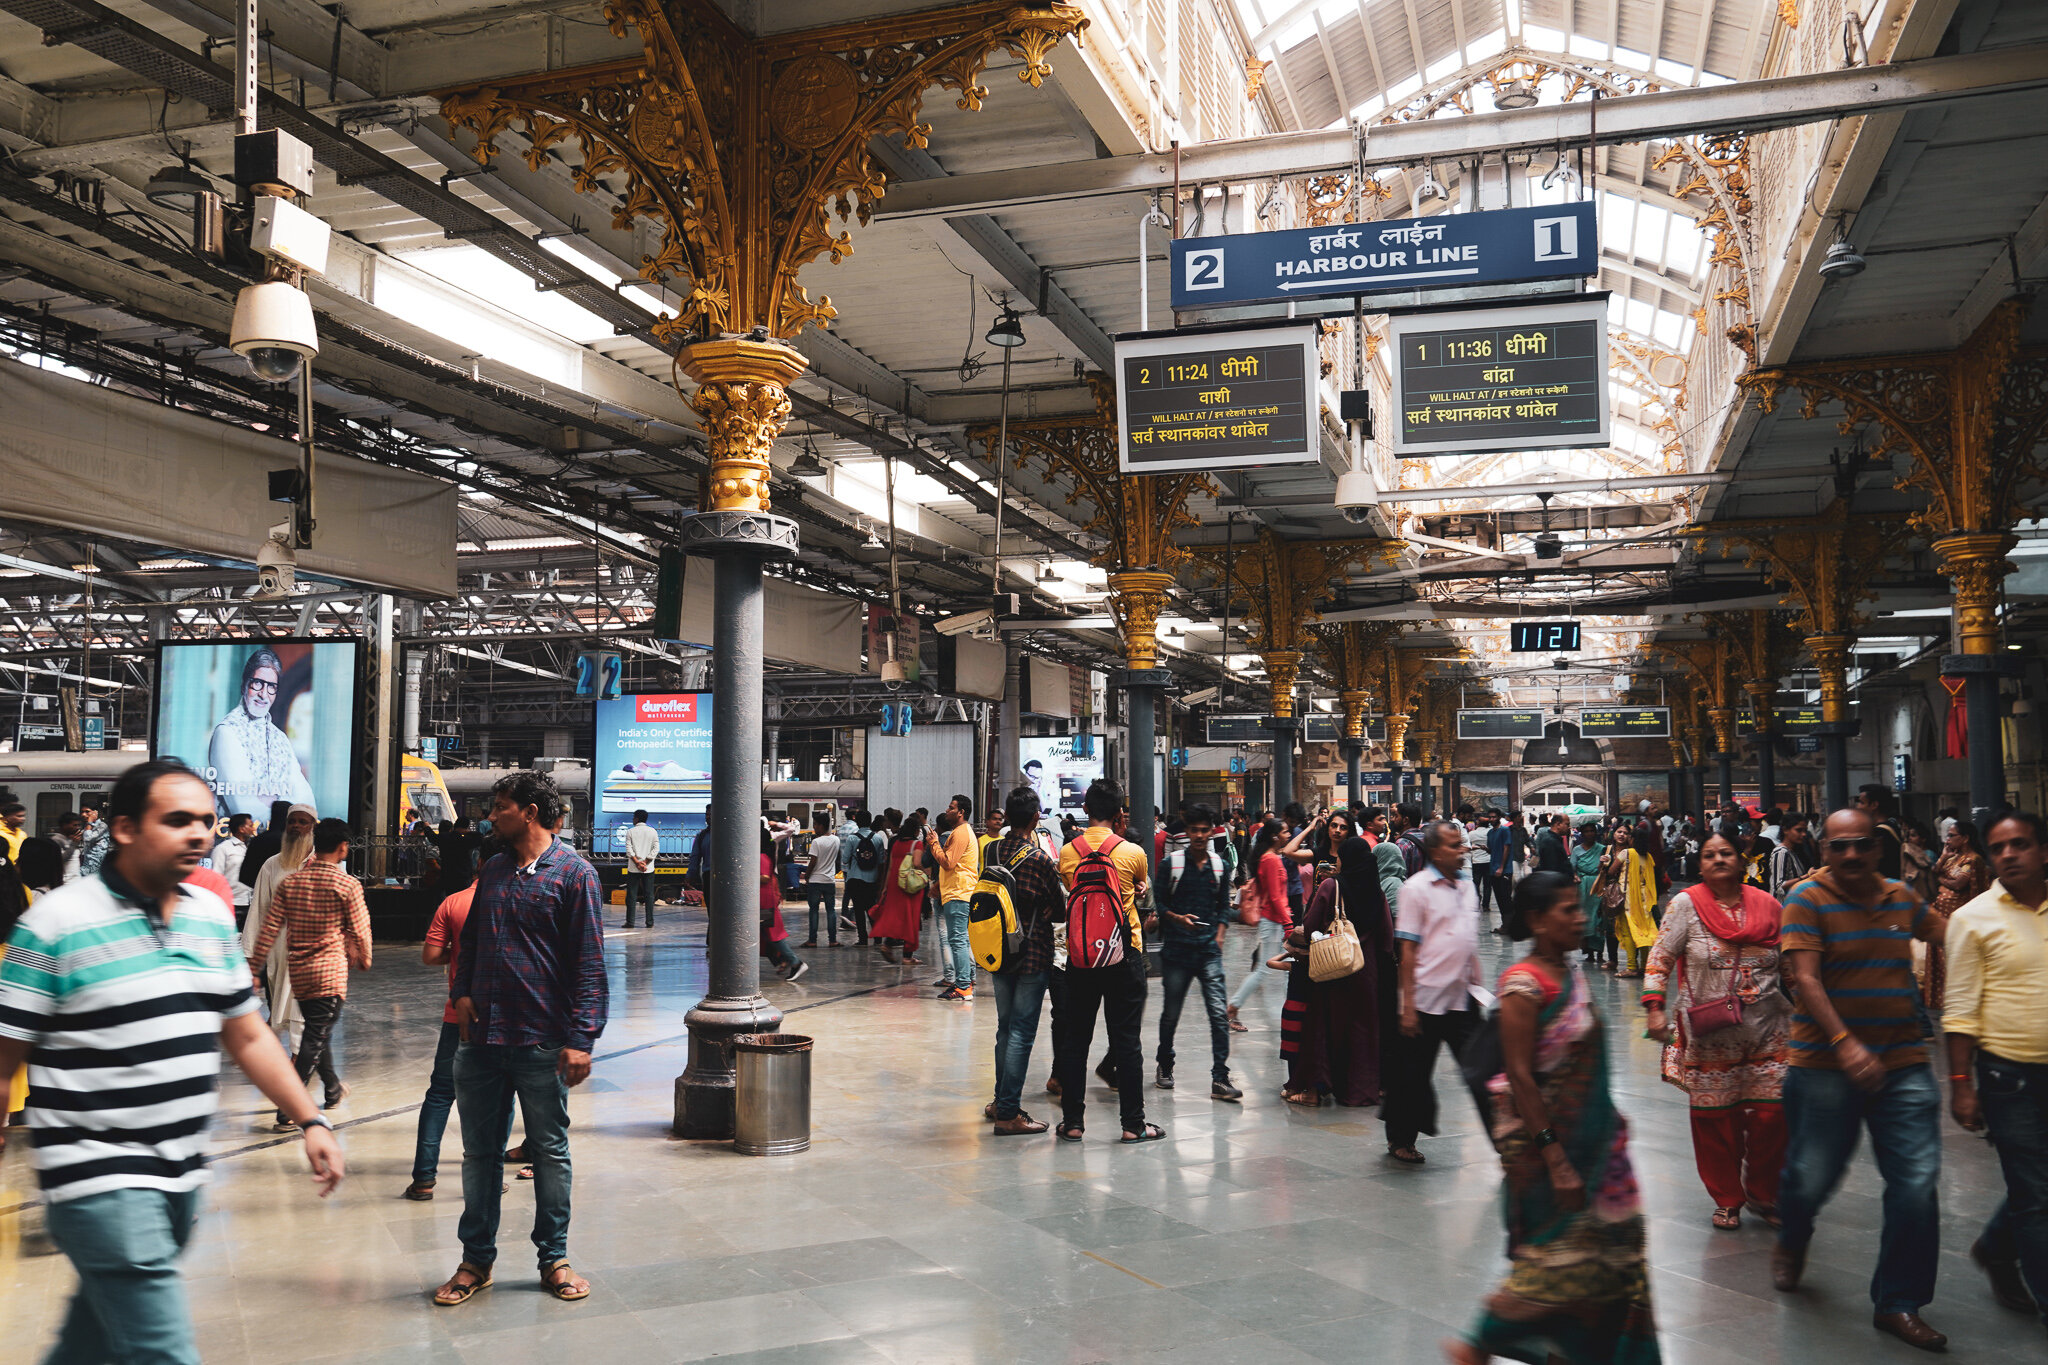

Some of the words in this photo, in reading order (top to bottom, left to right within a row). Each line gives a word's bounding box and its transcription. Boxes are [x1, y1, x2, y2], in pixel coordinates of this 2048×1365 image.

[1309, 228, 1362, 254] हार्बर
[1378, 221, 1446, 246] लाईन
[1540, 221, 1572, 257] 1
[1191, 254, 1219, 286] 2
[1275, 251, 1407, 276] HARBOUR
[1416, 244, 1478, 265] LINE
[1418, 344, 1426, 361] 1
[1447, 340, 1492, 359] 11:36
[1505, 332, 1548, 356] धीमी
[1140, 368, 1150, 384] 2
[1167, 363, 1209, 382] 11:24
[1220, 355, 1259, 378] धीमी
[1482, 366, 1515, 384] बांद्रा
[1199, 387, 1231, 405] वाशी
[1430, 393, 1452, 402] WILL
[1452, 391, 1475, 401] HALT
[1477, 390, 1490, 400] AT
[1152, 415, 1172, 423] WILL
[1173, 412, 1194, 422] HALT
[1196, 411, 1206, 420] AT
[1406, 406, 1431, 424] सर्व
[1515, 400, 1559, 418] थांबेल
[1131, 427, 1154, 444] सर्व
[1230, 420, 1270, 438] थांबेल
[1521, 626, 1578, 649] 1121
[576, 655, 593, 695] 2
[602, 656, 622, 697] 2
[641, 699, 691, 712] duroflex
[881, 704, 894, 732] 3
[901, 706, 912, 733] 3
[616, 739, 674, 750] Orthopaedic
[618, 728, 648, 738] India's
[649, 728, 671, 739] Only
[1072, 735, 1083, 756] 4
[1171, 749, 1181, 765] 5
[1230, 758, 1239, 773] 6
